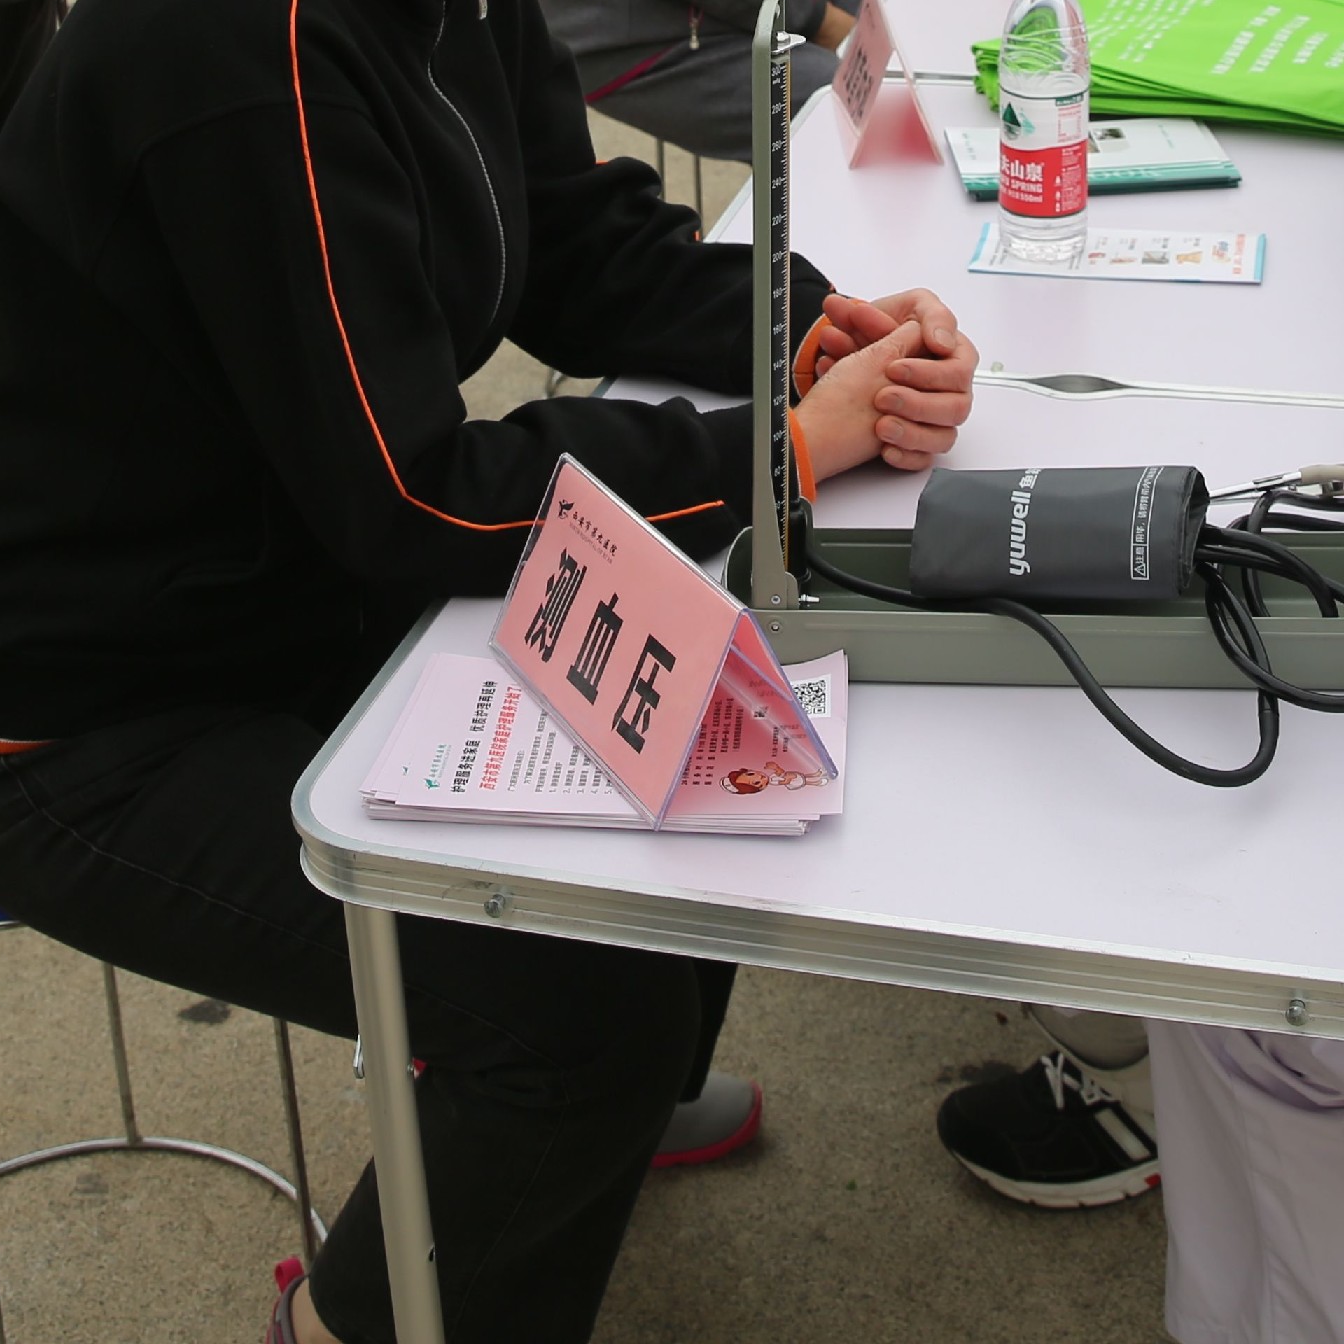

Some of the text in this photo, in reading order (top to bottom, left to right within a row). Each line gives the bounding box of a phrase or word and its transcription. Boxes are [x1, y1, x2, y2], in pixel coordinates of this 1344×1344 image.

[1009, 490, 1032, 576] yuwell
[524, 546, 677, 755] 测血压
